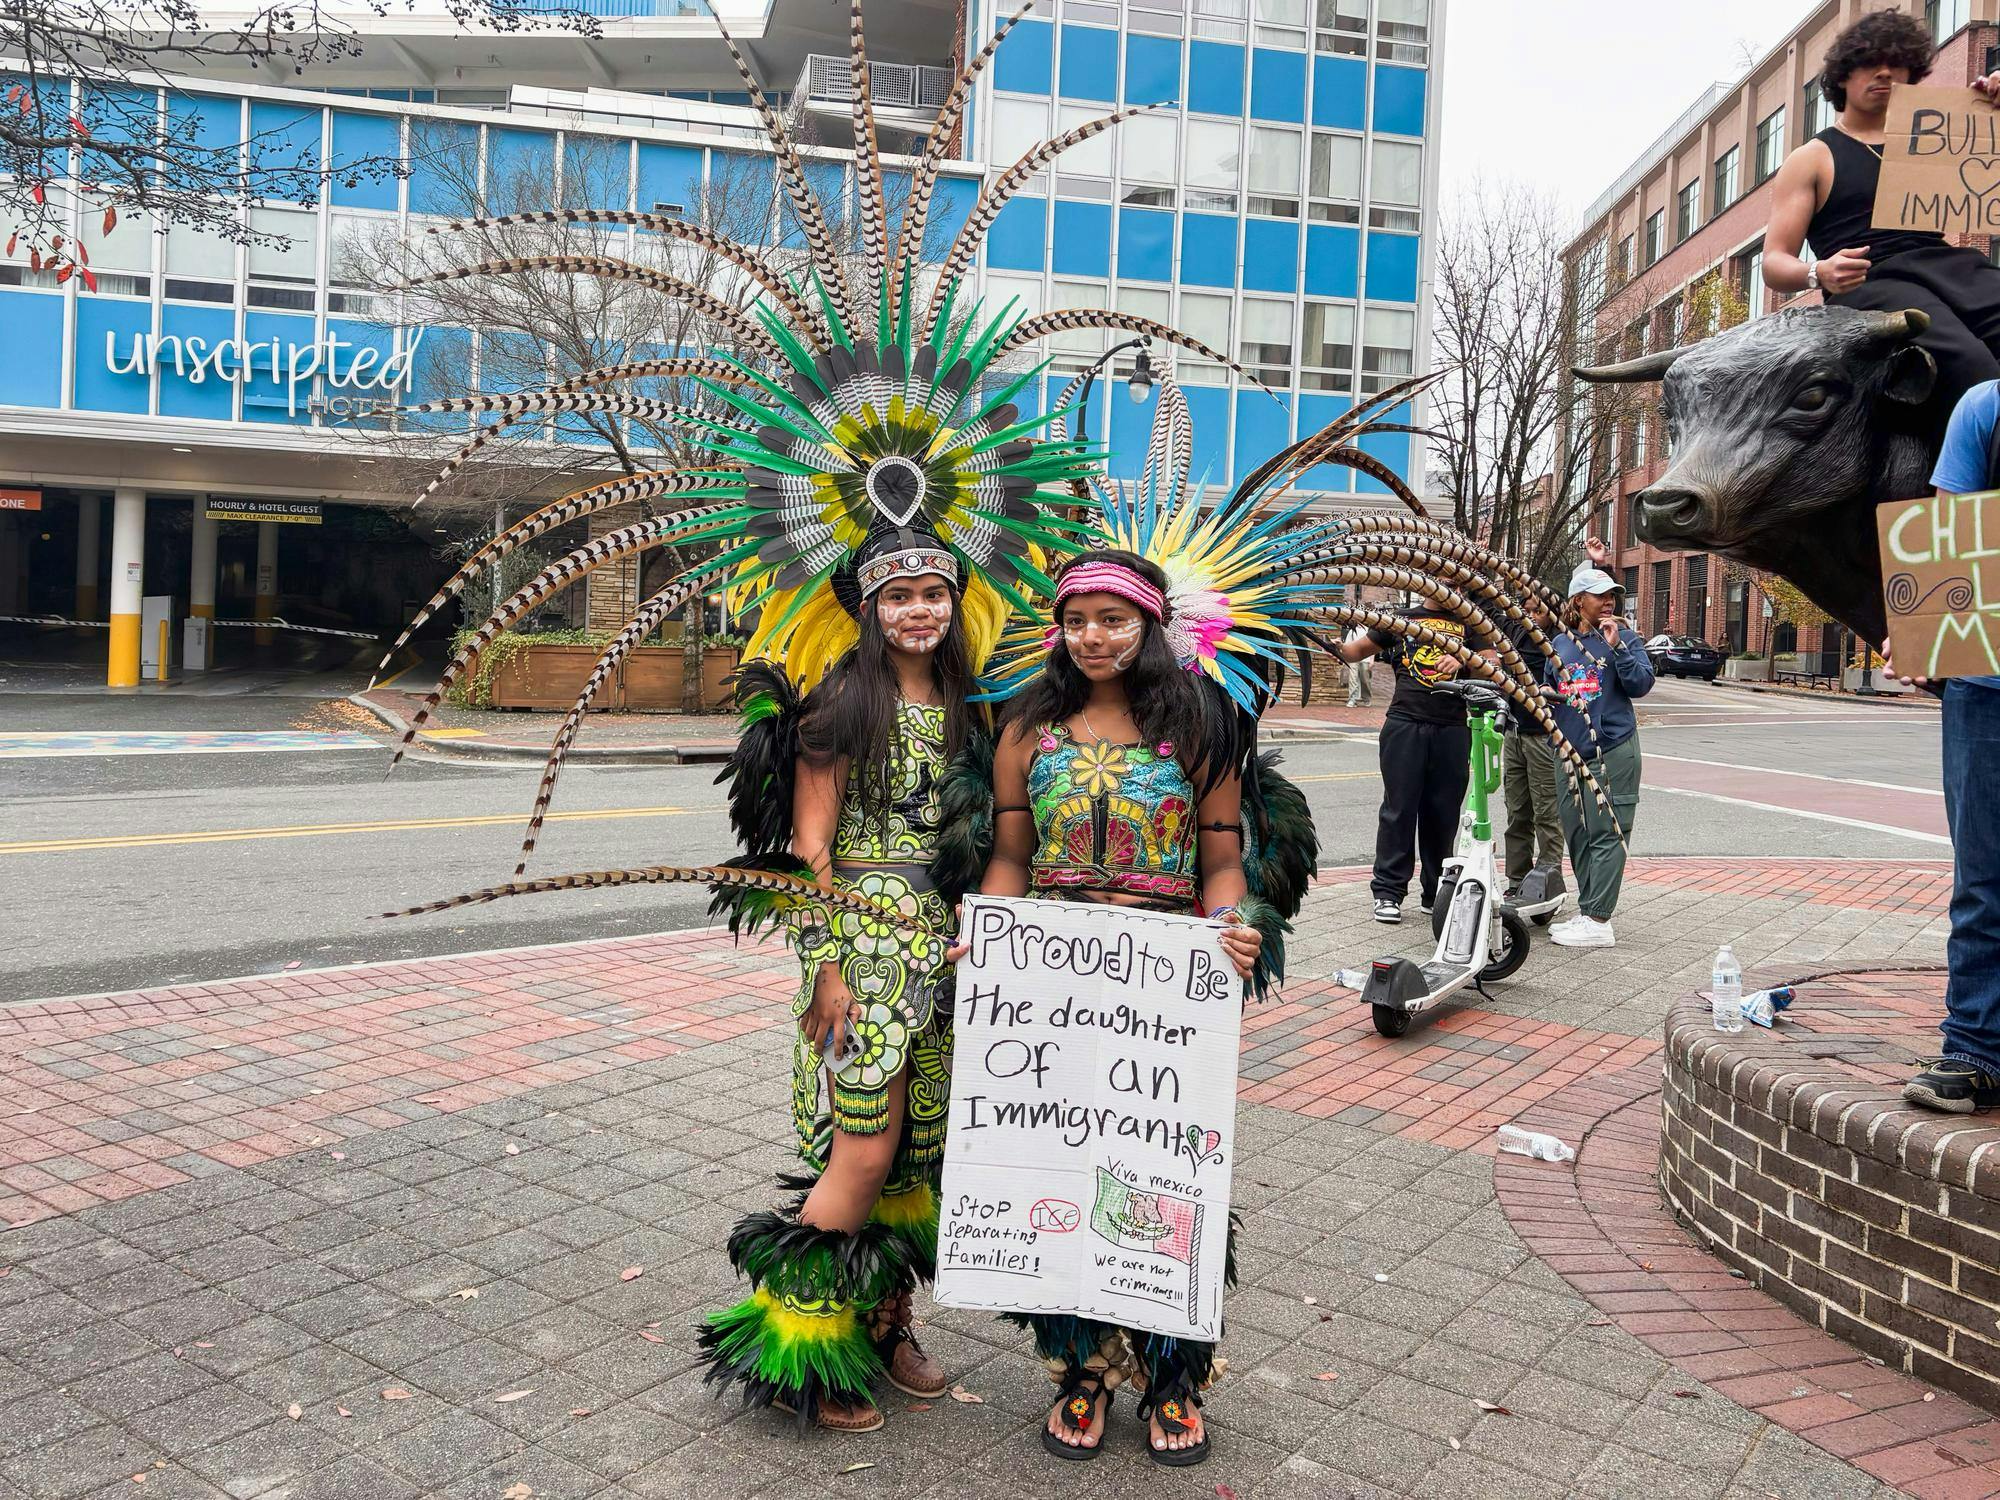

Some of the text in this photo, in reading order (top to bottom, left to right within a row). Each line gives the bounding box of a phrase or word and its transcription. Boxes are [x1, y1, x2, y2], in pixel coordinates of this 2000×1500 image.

[106, 325, 424, 417] unscripted
[210, 501, 319, 514] HOURLY & HOTEL GUEST
[970, 905, 1228, 1001] Proud to Be
[1049, 996, 1196, 1047] daughter
[1109, 1058, 1180, 1103] an
[961, 1095, 1185, 1157] Immigrant
[1107, 1155, 1203, 1198] Viva mexico
[1121, 1260, 1145, 1271] are
